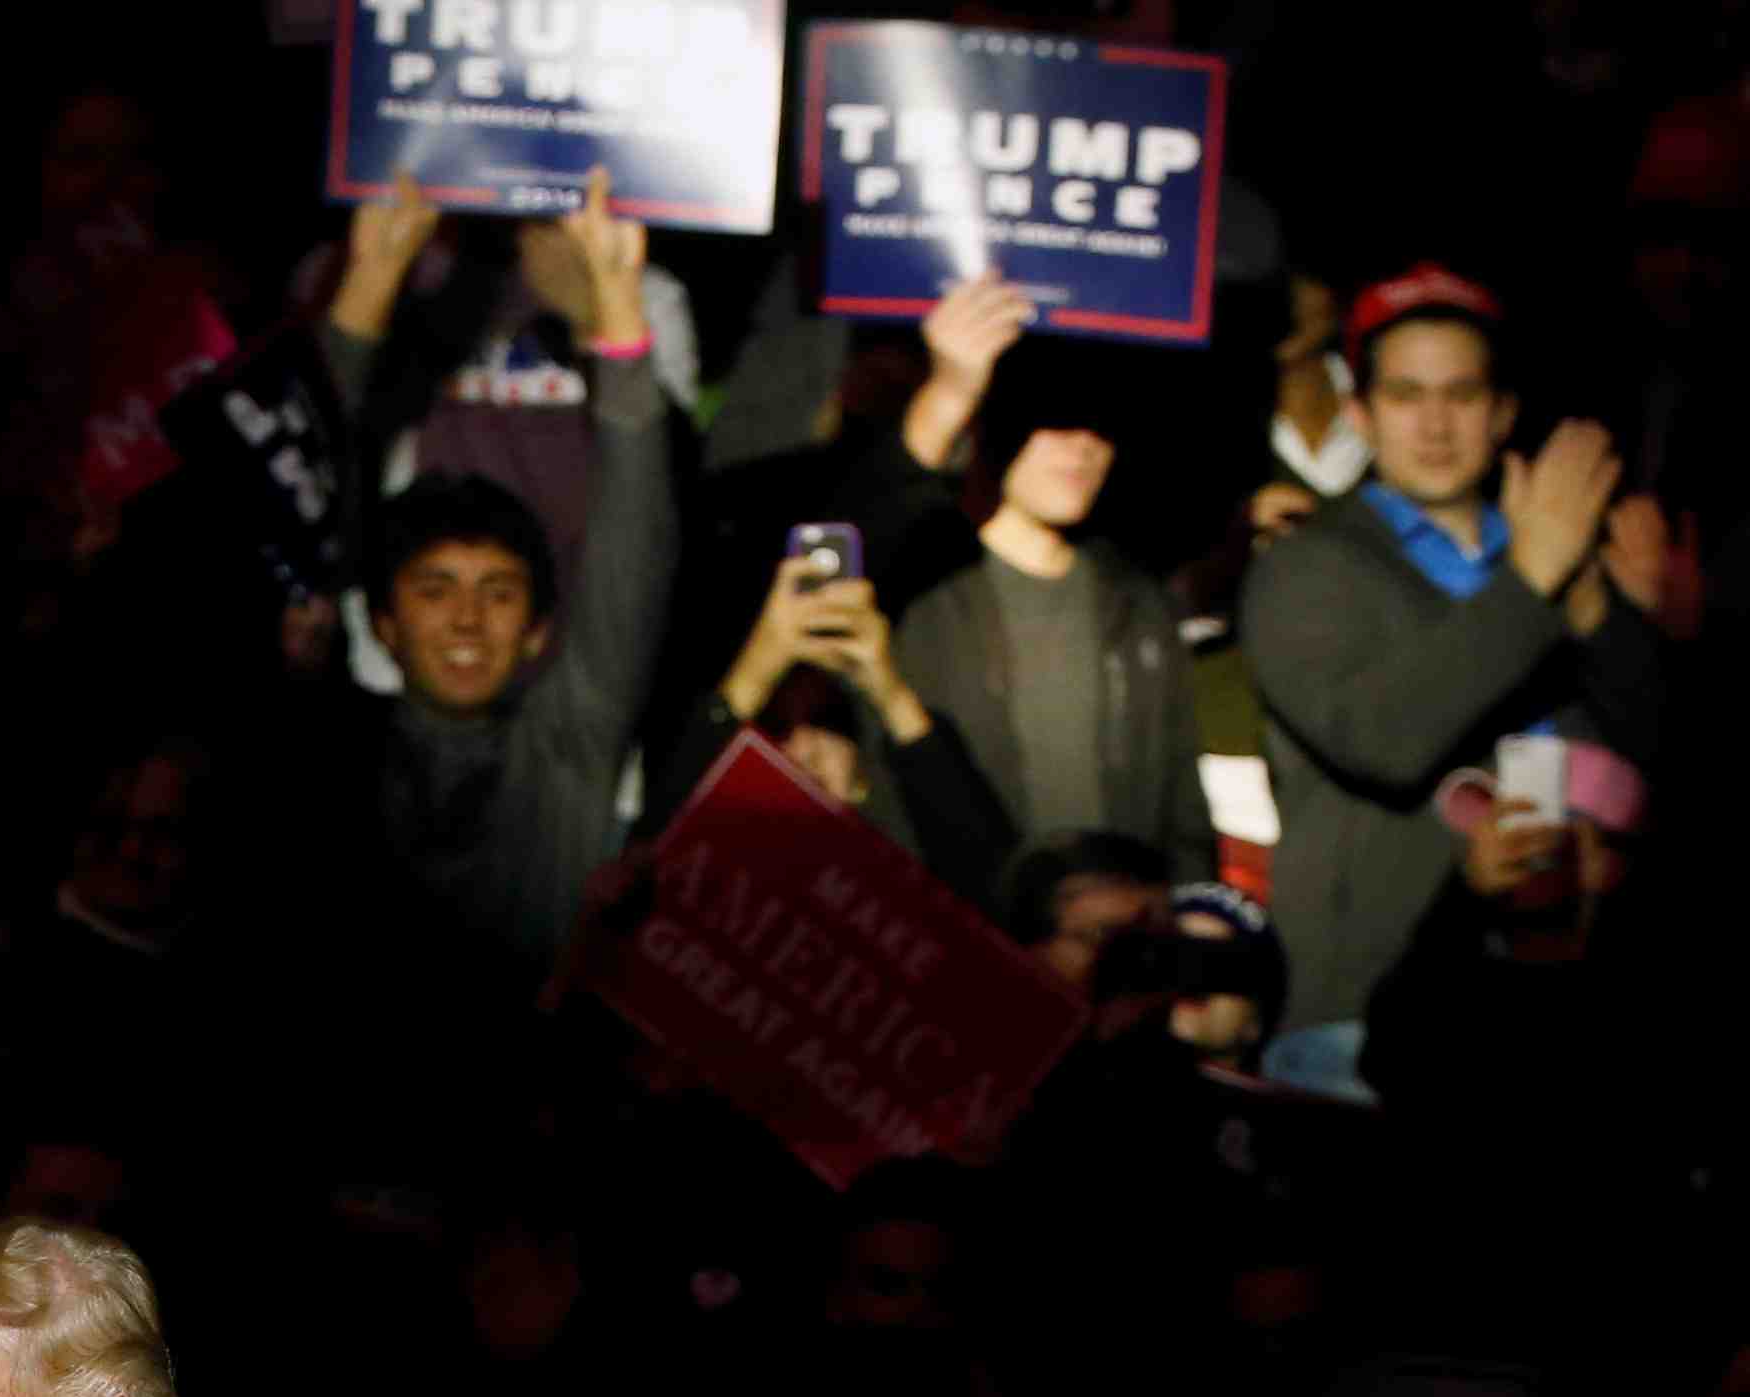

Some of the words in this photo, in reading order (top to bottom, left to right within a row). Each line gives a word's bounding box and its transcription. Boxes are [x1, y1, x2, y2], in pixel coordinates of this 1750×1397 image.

[826, 102, 1202, 186] TUMP
[853, 165, 1162, 230] PNCE
[810, 864, 947, 984] MAKE
[638, 917, 795, 1048] GREAT
